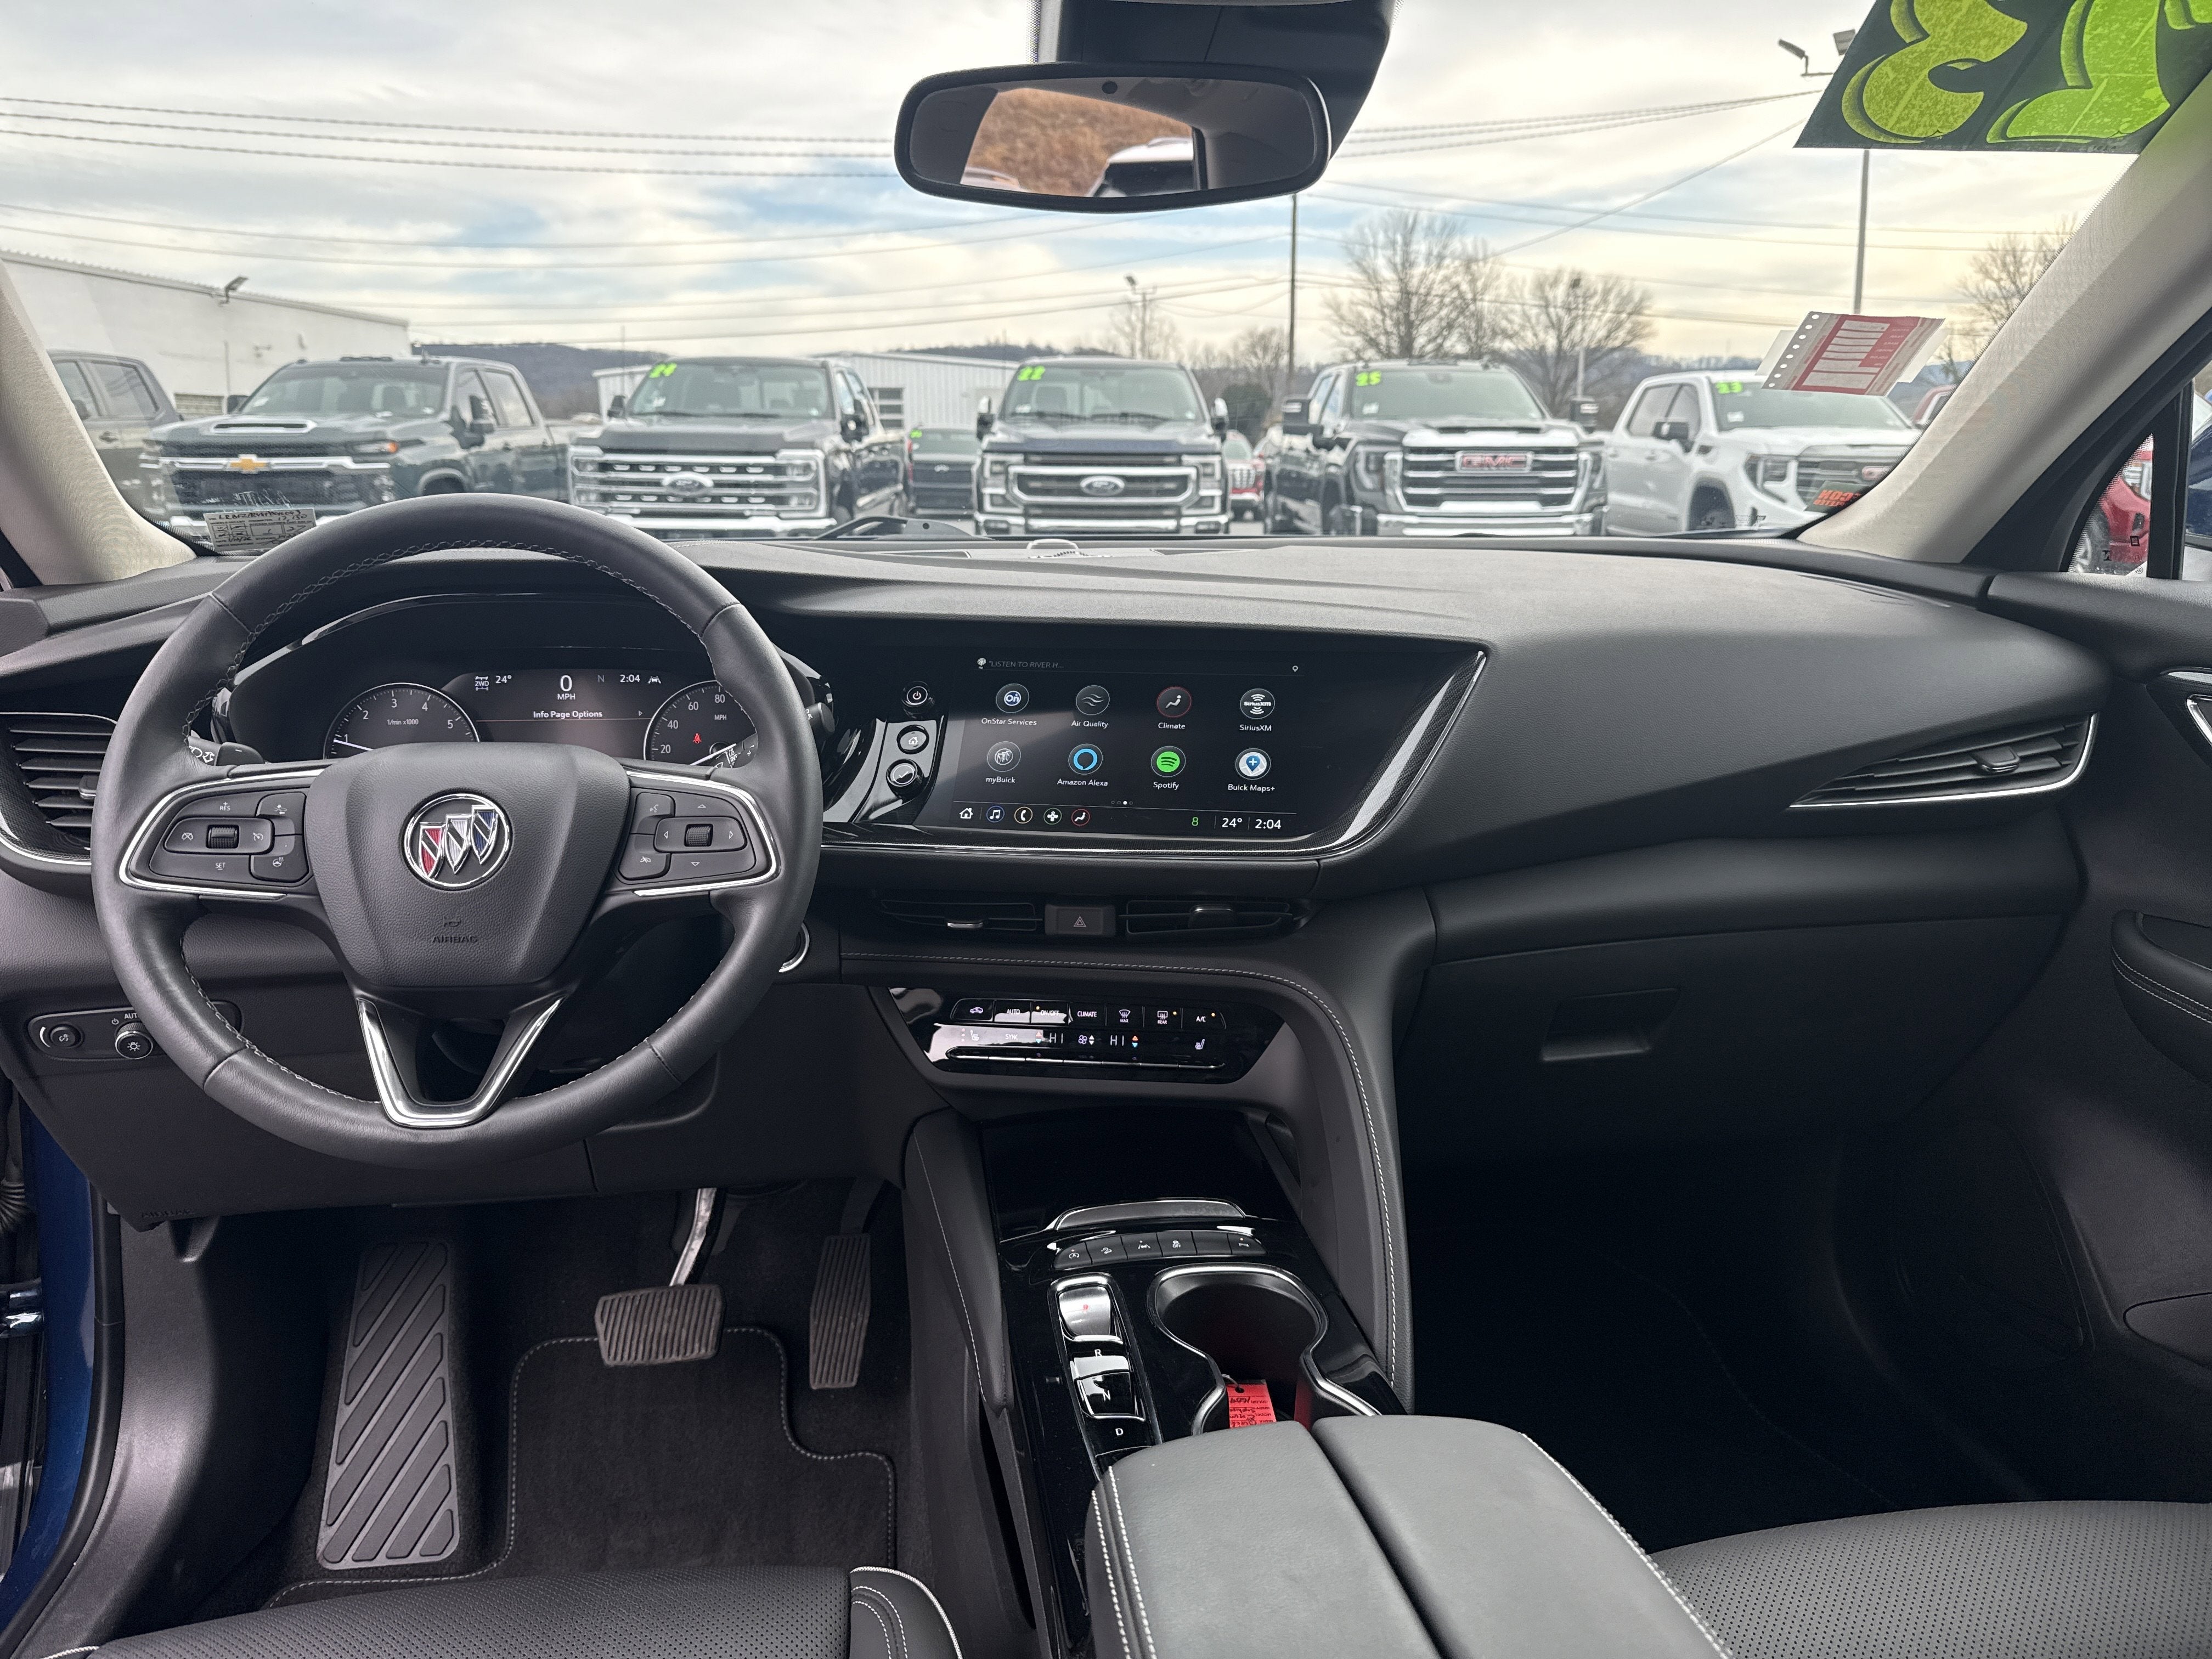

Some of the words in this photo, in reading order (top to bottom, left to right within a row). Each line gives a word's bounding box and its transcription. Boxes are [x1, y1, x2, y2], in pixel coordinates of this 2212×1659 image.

[1461, 455, 1527, 469] GMC
[495, 675, 512, 684] 24°
[619, 674, 640, 683] 2:04
[560, 675, 572, 692] 0
[391, 698, 397, 708] 3
[714, 694, 725, 703] 80
[422, 702, 428, 711] 4
[688, 701, 699, 710] 60
[363, 710, 369, 720] 2
[551, 711, 570, 719] Page
[572, 710, 603, 719] Options
[448, 720, 453, 729] 5
[667, 720, 679, 729] 40
[1083, 720, 1109, 729] Quality
[344, 734, 348, 743] 1
[661, 744, 671, 753] 20
[986, 776, 1015, 784] myBuick
[1153, 781, 1180, 790] Spotify
[1191, 817, 1199, 826] 8
[1221, 817, 1243, 827] 24°
[1255, 819, 1282, 829] 2:04
[432, 935, 478, 943] AIRBAG
[1094, 1348, 1103, 1357] R
[1103, 1390, 1111, 1401] N
[1115, 1427, 1124, 1436] D
